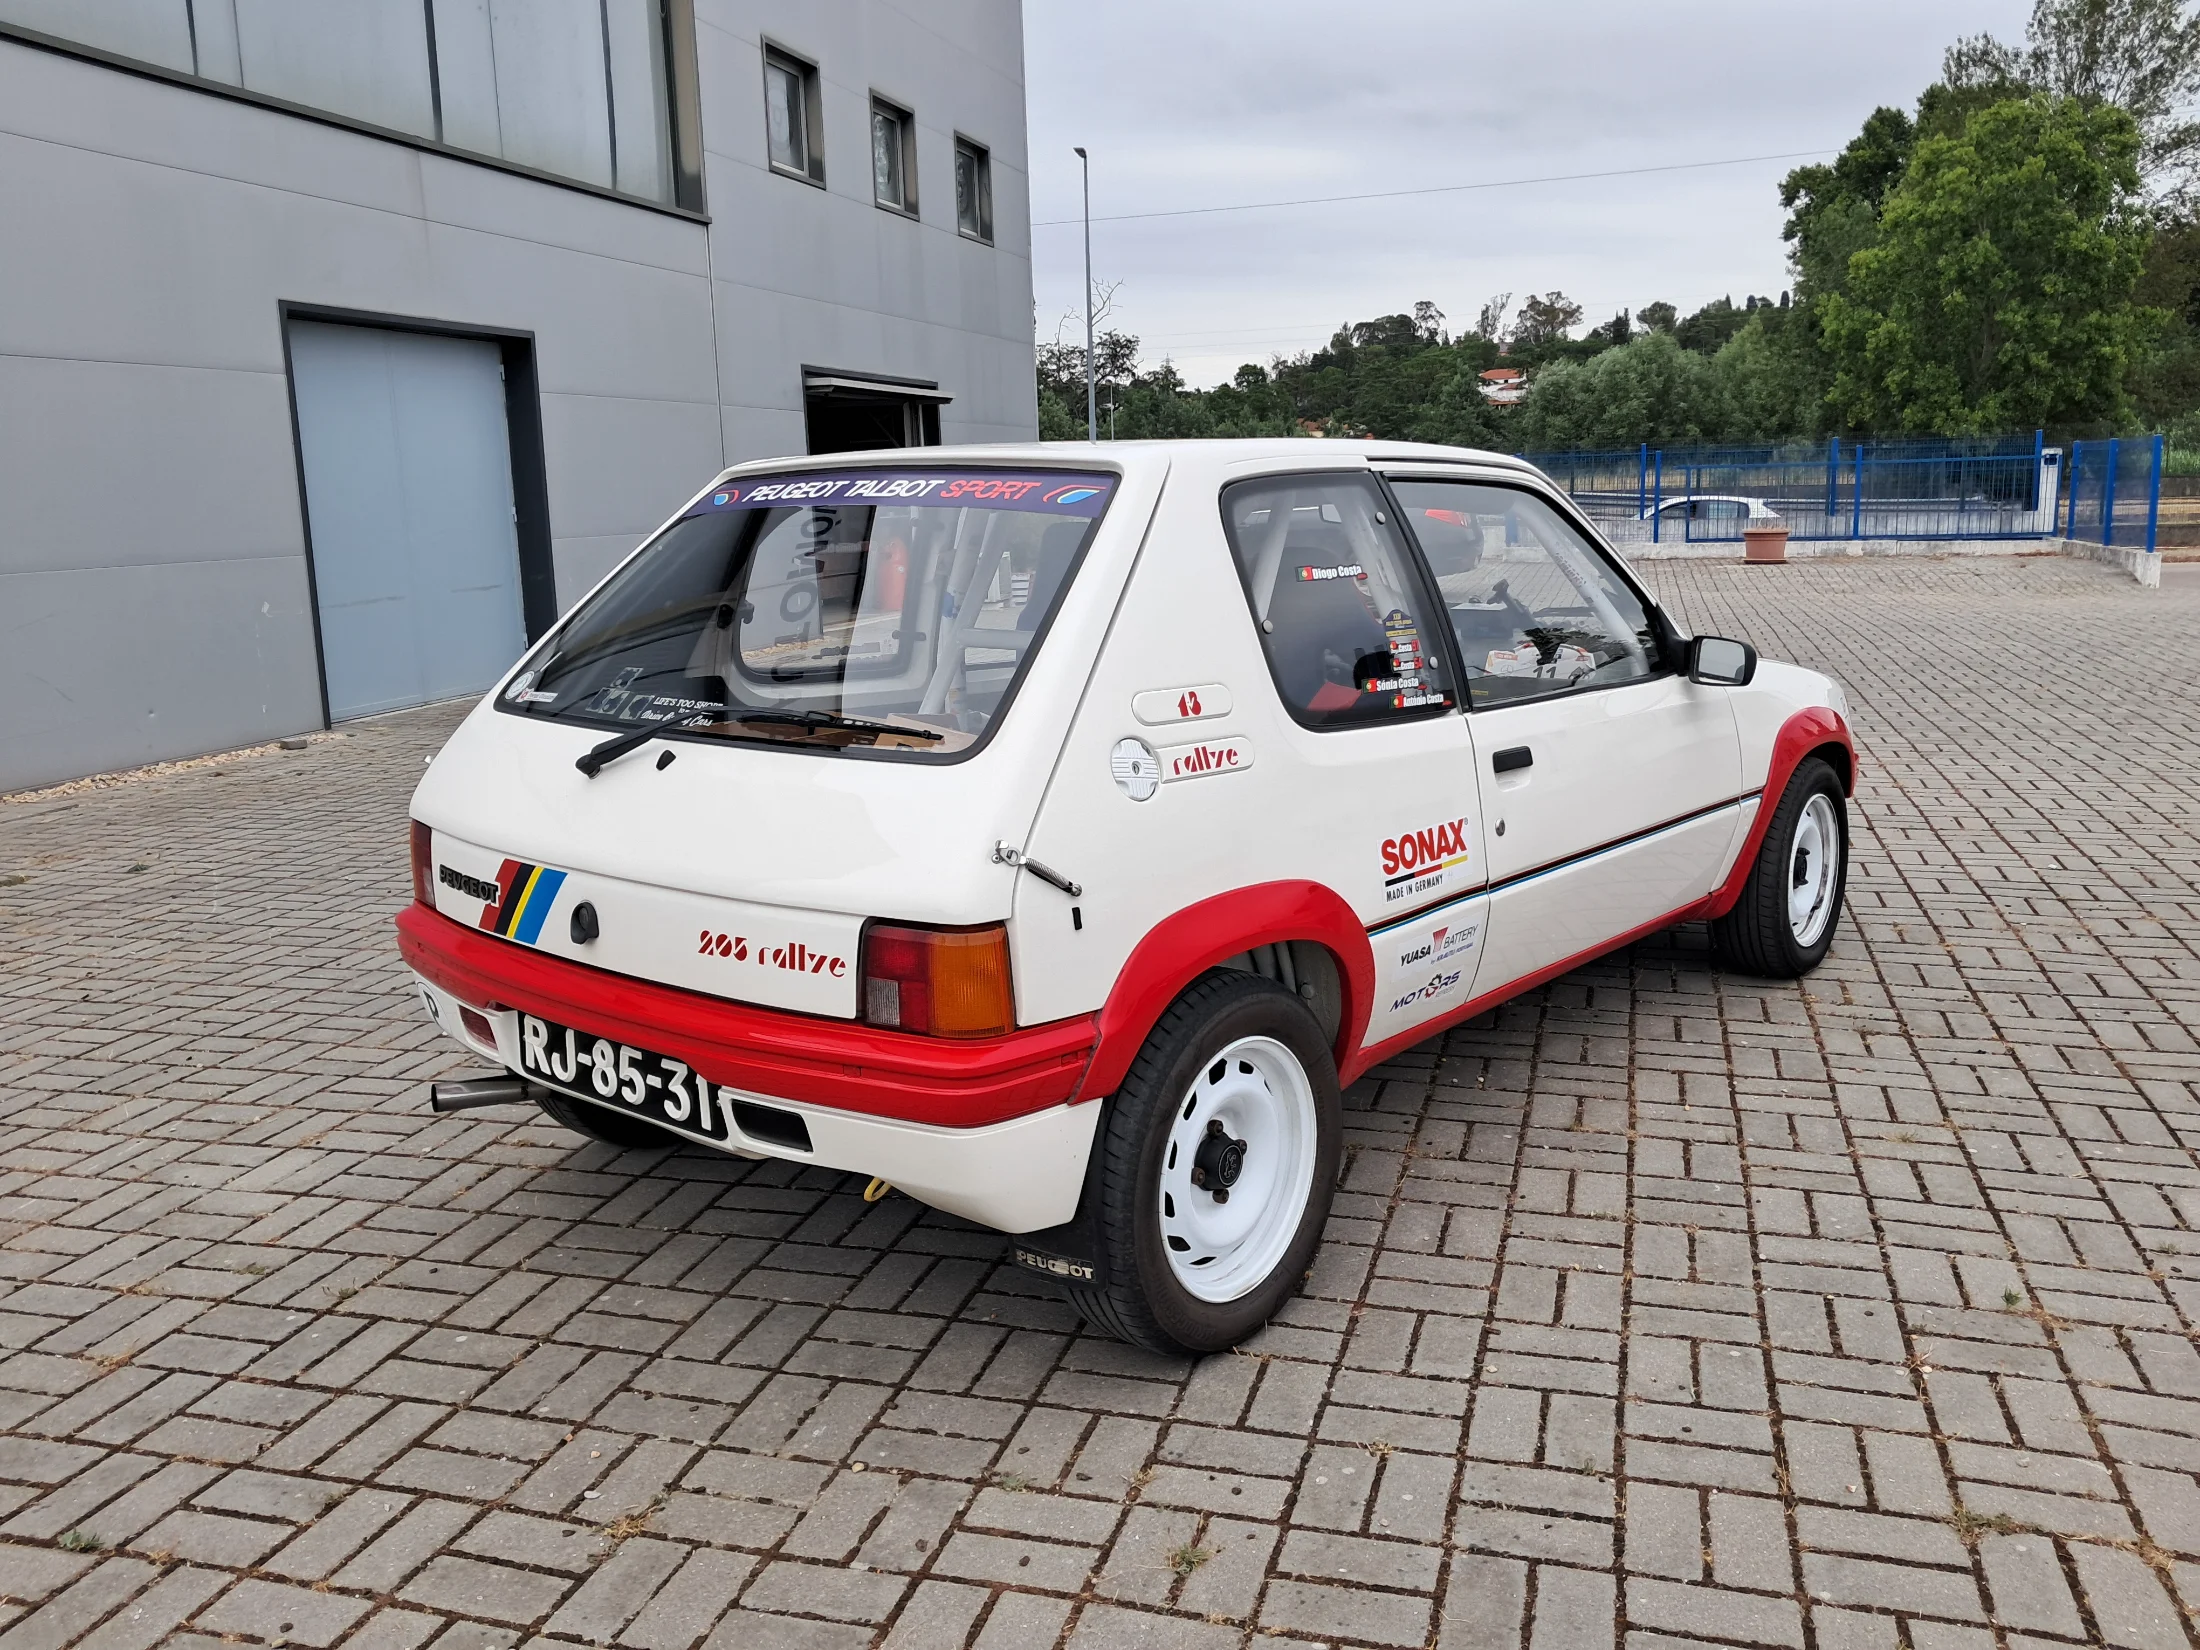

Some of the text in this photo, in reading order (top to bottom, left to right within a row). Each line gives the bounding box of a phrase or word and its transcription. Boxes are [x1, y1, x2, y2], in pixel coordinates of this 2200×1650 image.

[742, 479, 1042, 502] PEUGEOT TALBOT SPORT
[1312, 565, 1362, 580] Diogo Costa
[1398, 677, 1419, 689] Costa
[676, 698, 695, 708] TOO
[1426, 694, 1444, 705] Costa
[1173, 746, 1239, 776] rallye
[1381, 818, 1468, 876] SONAX
[439, 864, 499, 904] PEUGEOT
[1386, 873, 1443, 902] MADE IN GERMANY
[698, 930, 846, 978] 205 rallye
[1400, 924, 1479, 967] YUASA BATTERY
[524, 1014, 712, 1132] RJ-85-31
[1016, 1249, 1094, 1280] PEUGEOT
